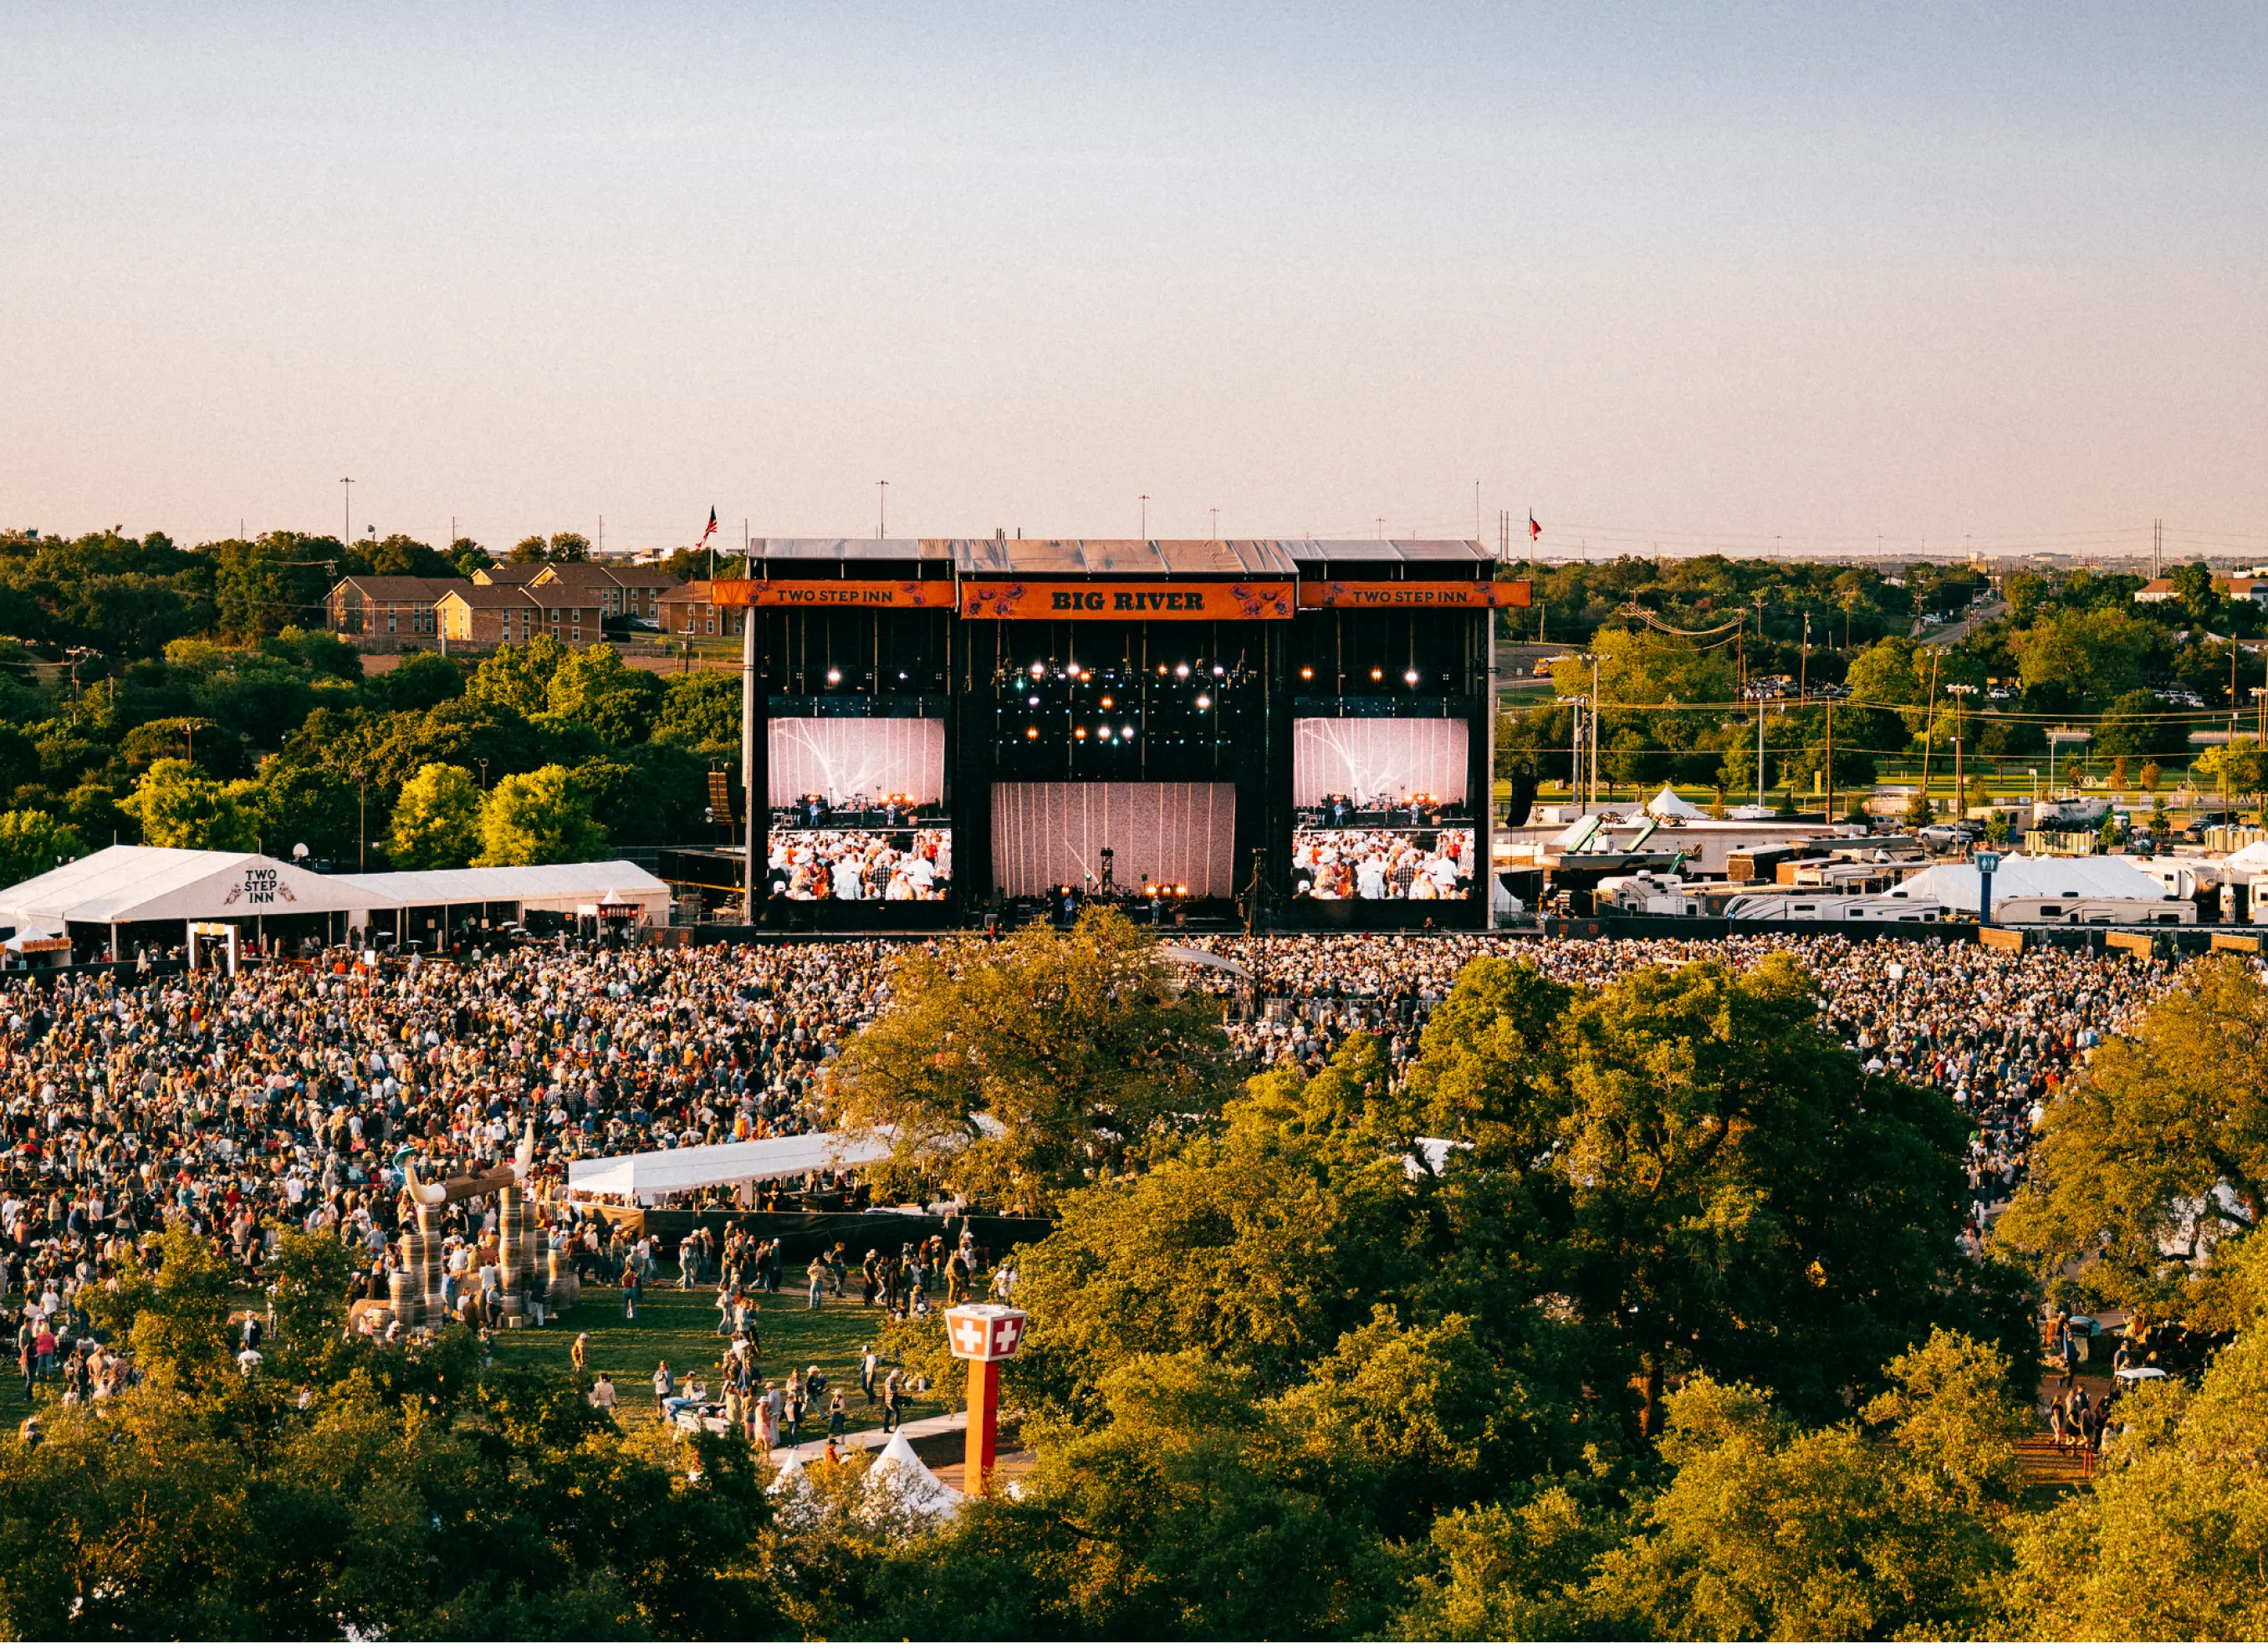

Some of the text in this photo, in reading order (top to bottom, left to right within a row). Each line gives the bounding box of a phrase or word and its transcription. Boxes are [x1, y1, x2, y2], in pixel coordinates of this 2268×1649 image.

[777, 590, 893, 602] TWO STEP INN
[1051, 592, 1205, 610] BIG RIVER
[1353, 590, 1468, 602] TWO STEP INN
[245, 869, 277, 881] TWO
[244, 881, 278, 892] STEP
[249, 891, 274, 903] INN
